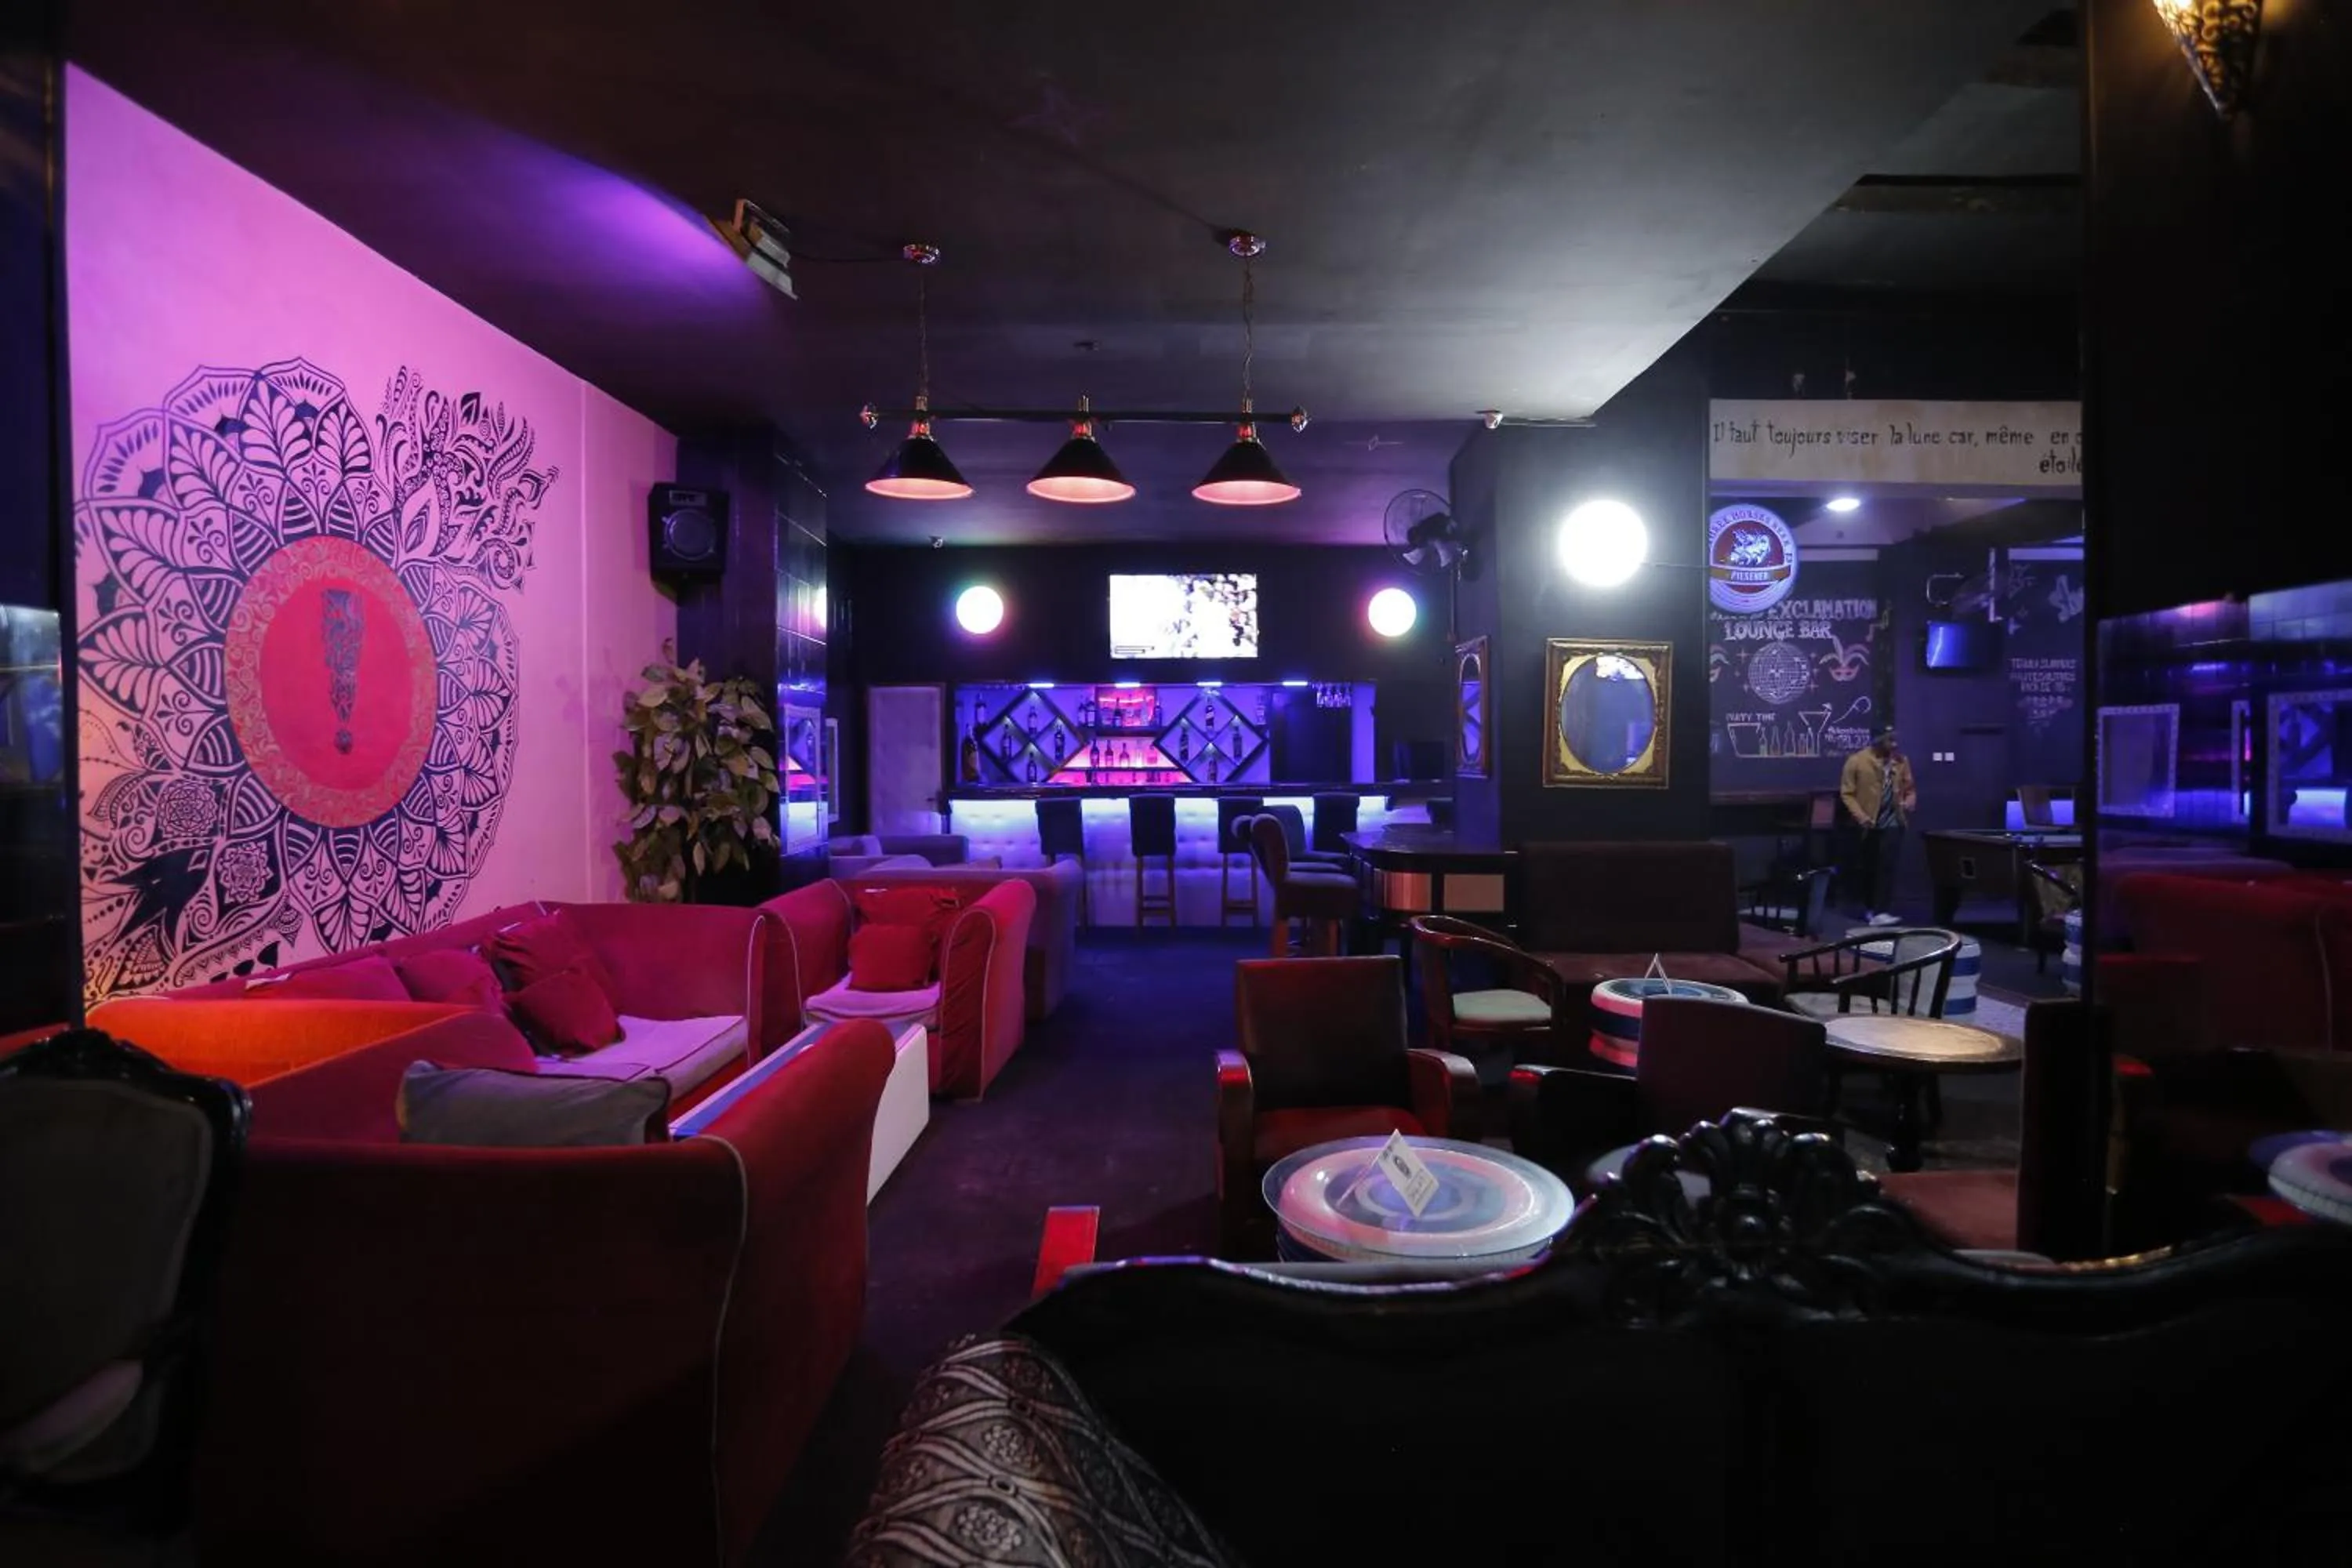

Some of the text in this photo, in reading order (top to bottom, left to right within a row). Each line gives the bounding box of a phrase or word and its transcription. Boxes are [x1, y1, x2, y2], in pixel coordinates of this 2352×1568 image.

[1712, 422, 1724, 443] Il
[1730, 419, 1761, 443] faut
[1766, 420, 1831, 459] toujours
[1836, 428, 1879, 445] viser
[1889, 424, 1903, 446] la
[1907, 423, 1941, 445] lune
[1948, 430, 1979, 448] car,
[1986, 424, 2034, 446] même
[2051, 431, 2070, 445] en
[1768, 598, 1877, 620] EXCLAMATION
[1724, 619, 1833, 641] LOUNGE BAR
